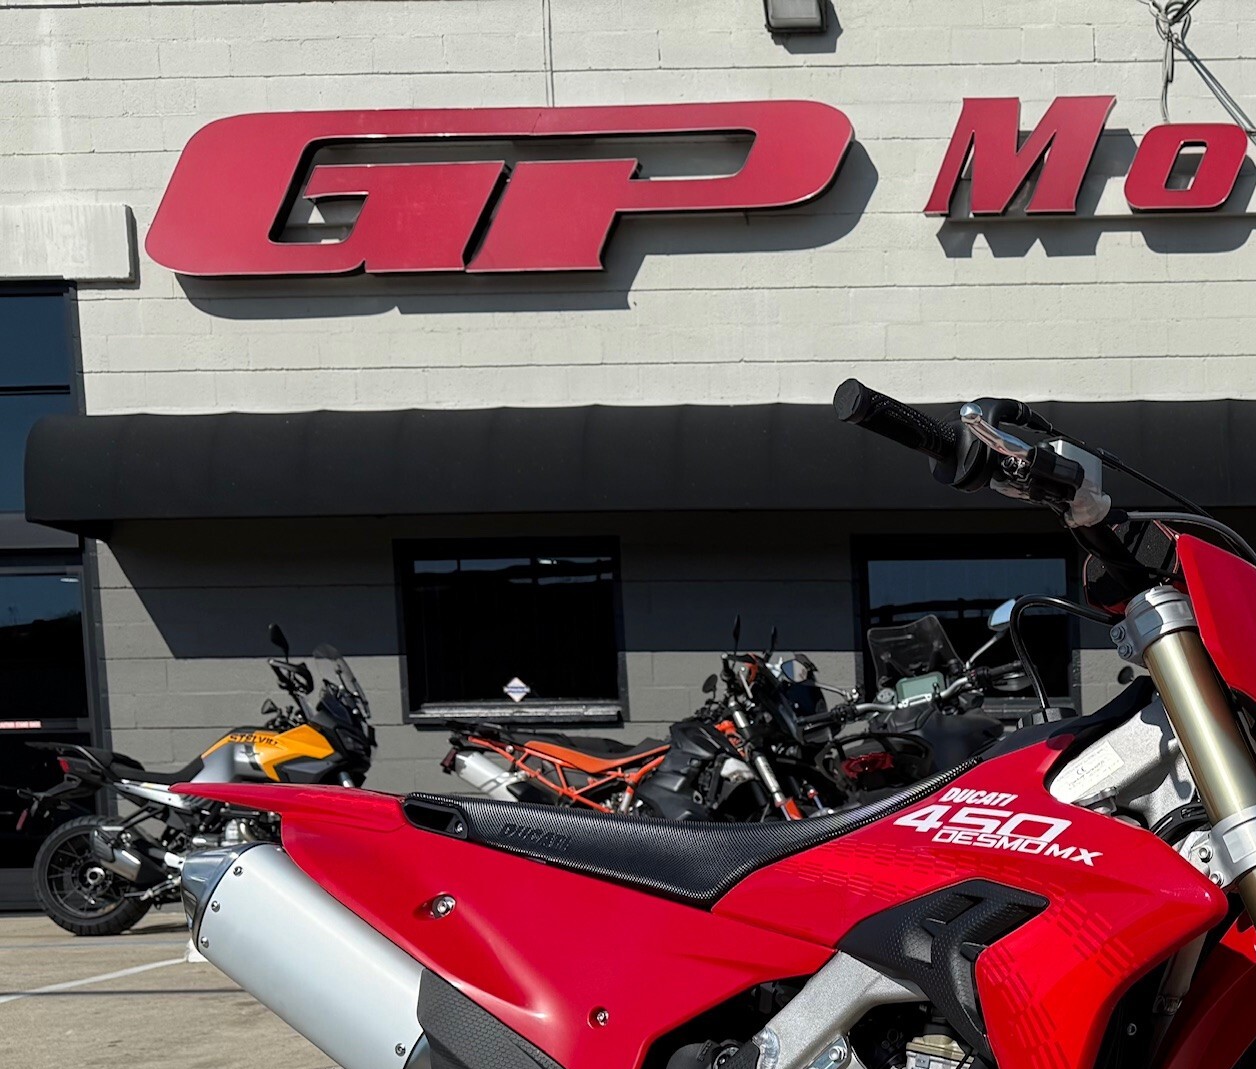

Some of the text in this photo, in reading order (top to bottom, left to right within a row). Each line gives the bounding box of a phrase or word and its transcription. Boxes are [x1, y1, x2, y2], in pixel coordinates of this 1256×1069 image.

[145, 99, 854, 276] GP
[939, 787, 1019, 807] DUCATI
[500, 823, 571, 852] DUCATI
[893, 804, 1072, 843] 450
[932, 829, 1103, 867] DESMO MX
